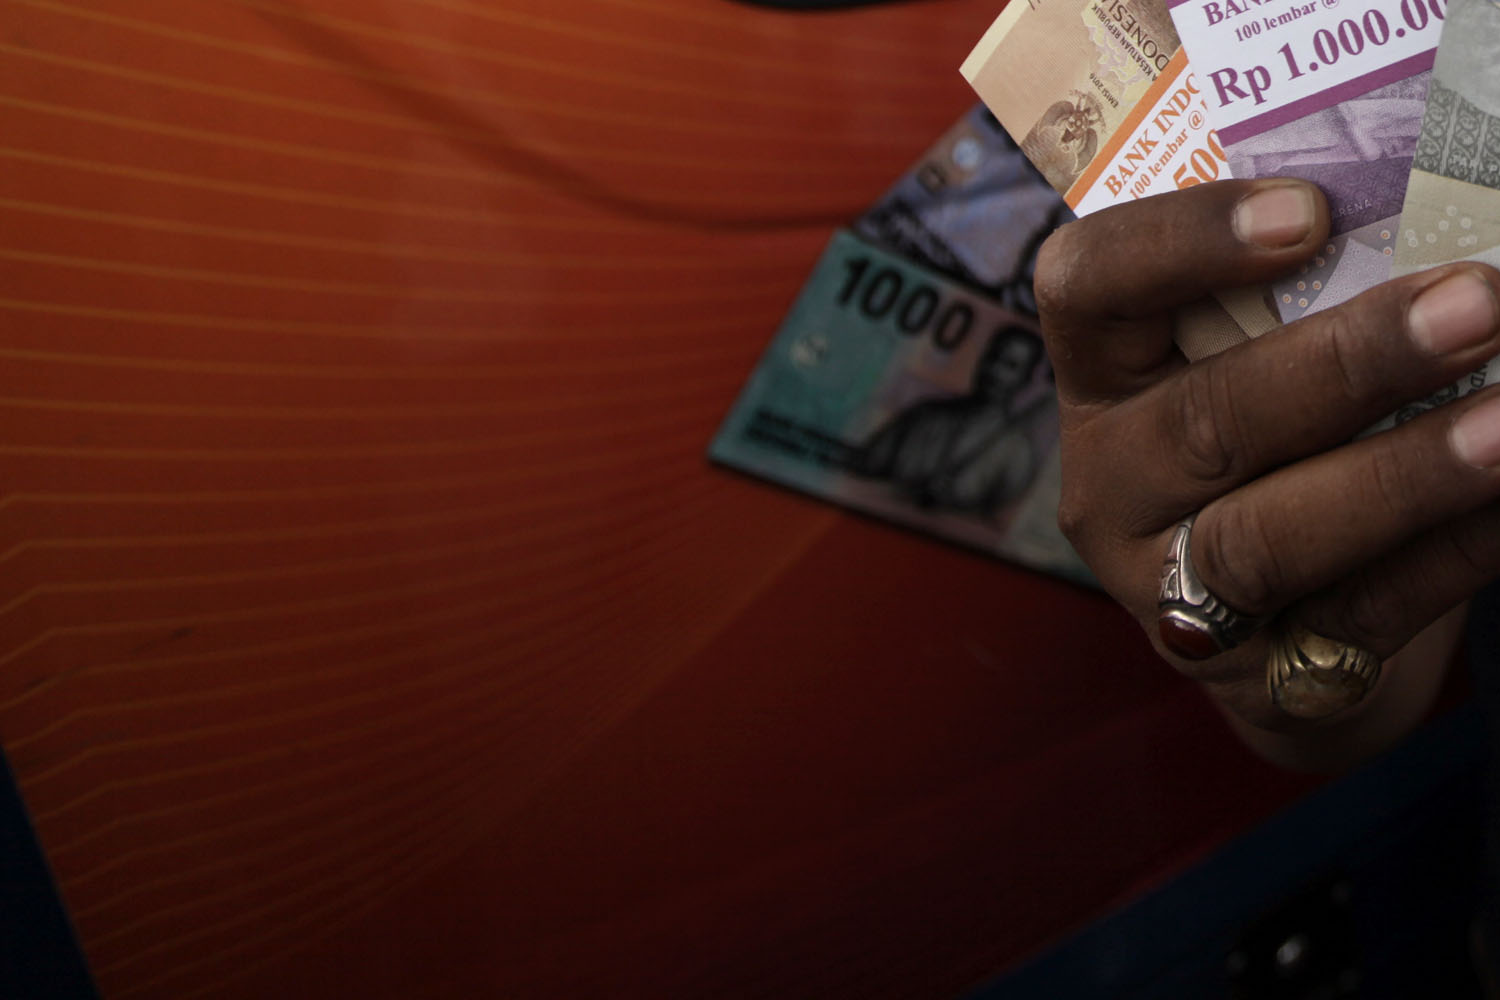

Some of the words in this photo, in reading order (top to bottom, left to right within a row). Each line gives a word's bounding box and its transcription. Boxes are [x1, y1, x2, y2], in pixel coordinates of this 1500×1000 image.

[1089, 1, 1123, 39] REPUBLIK
[1233, 19, 1263, 43] 100
[1117, 35, 1154, 77] KESATUAN
[1087, 70, 1105, 90] 2016
[1099, 86, 1120, 109] EMISI
[1208, 60, 1272, 109] Rp
[1101, 127, 1161, 197] BANK
[1126, 172, 1154, 201] 100
[1145, 126, 1192, 178] lembar
[1183, 107, 1208, 133] @
[834, 255, 976, 353] 1000
